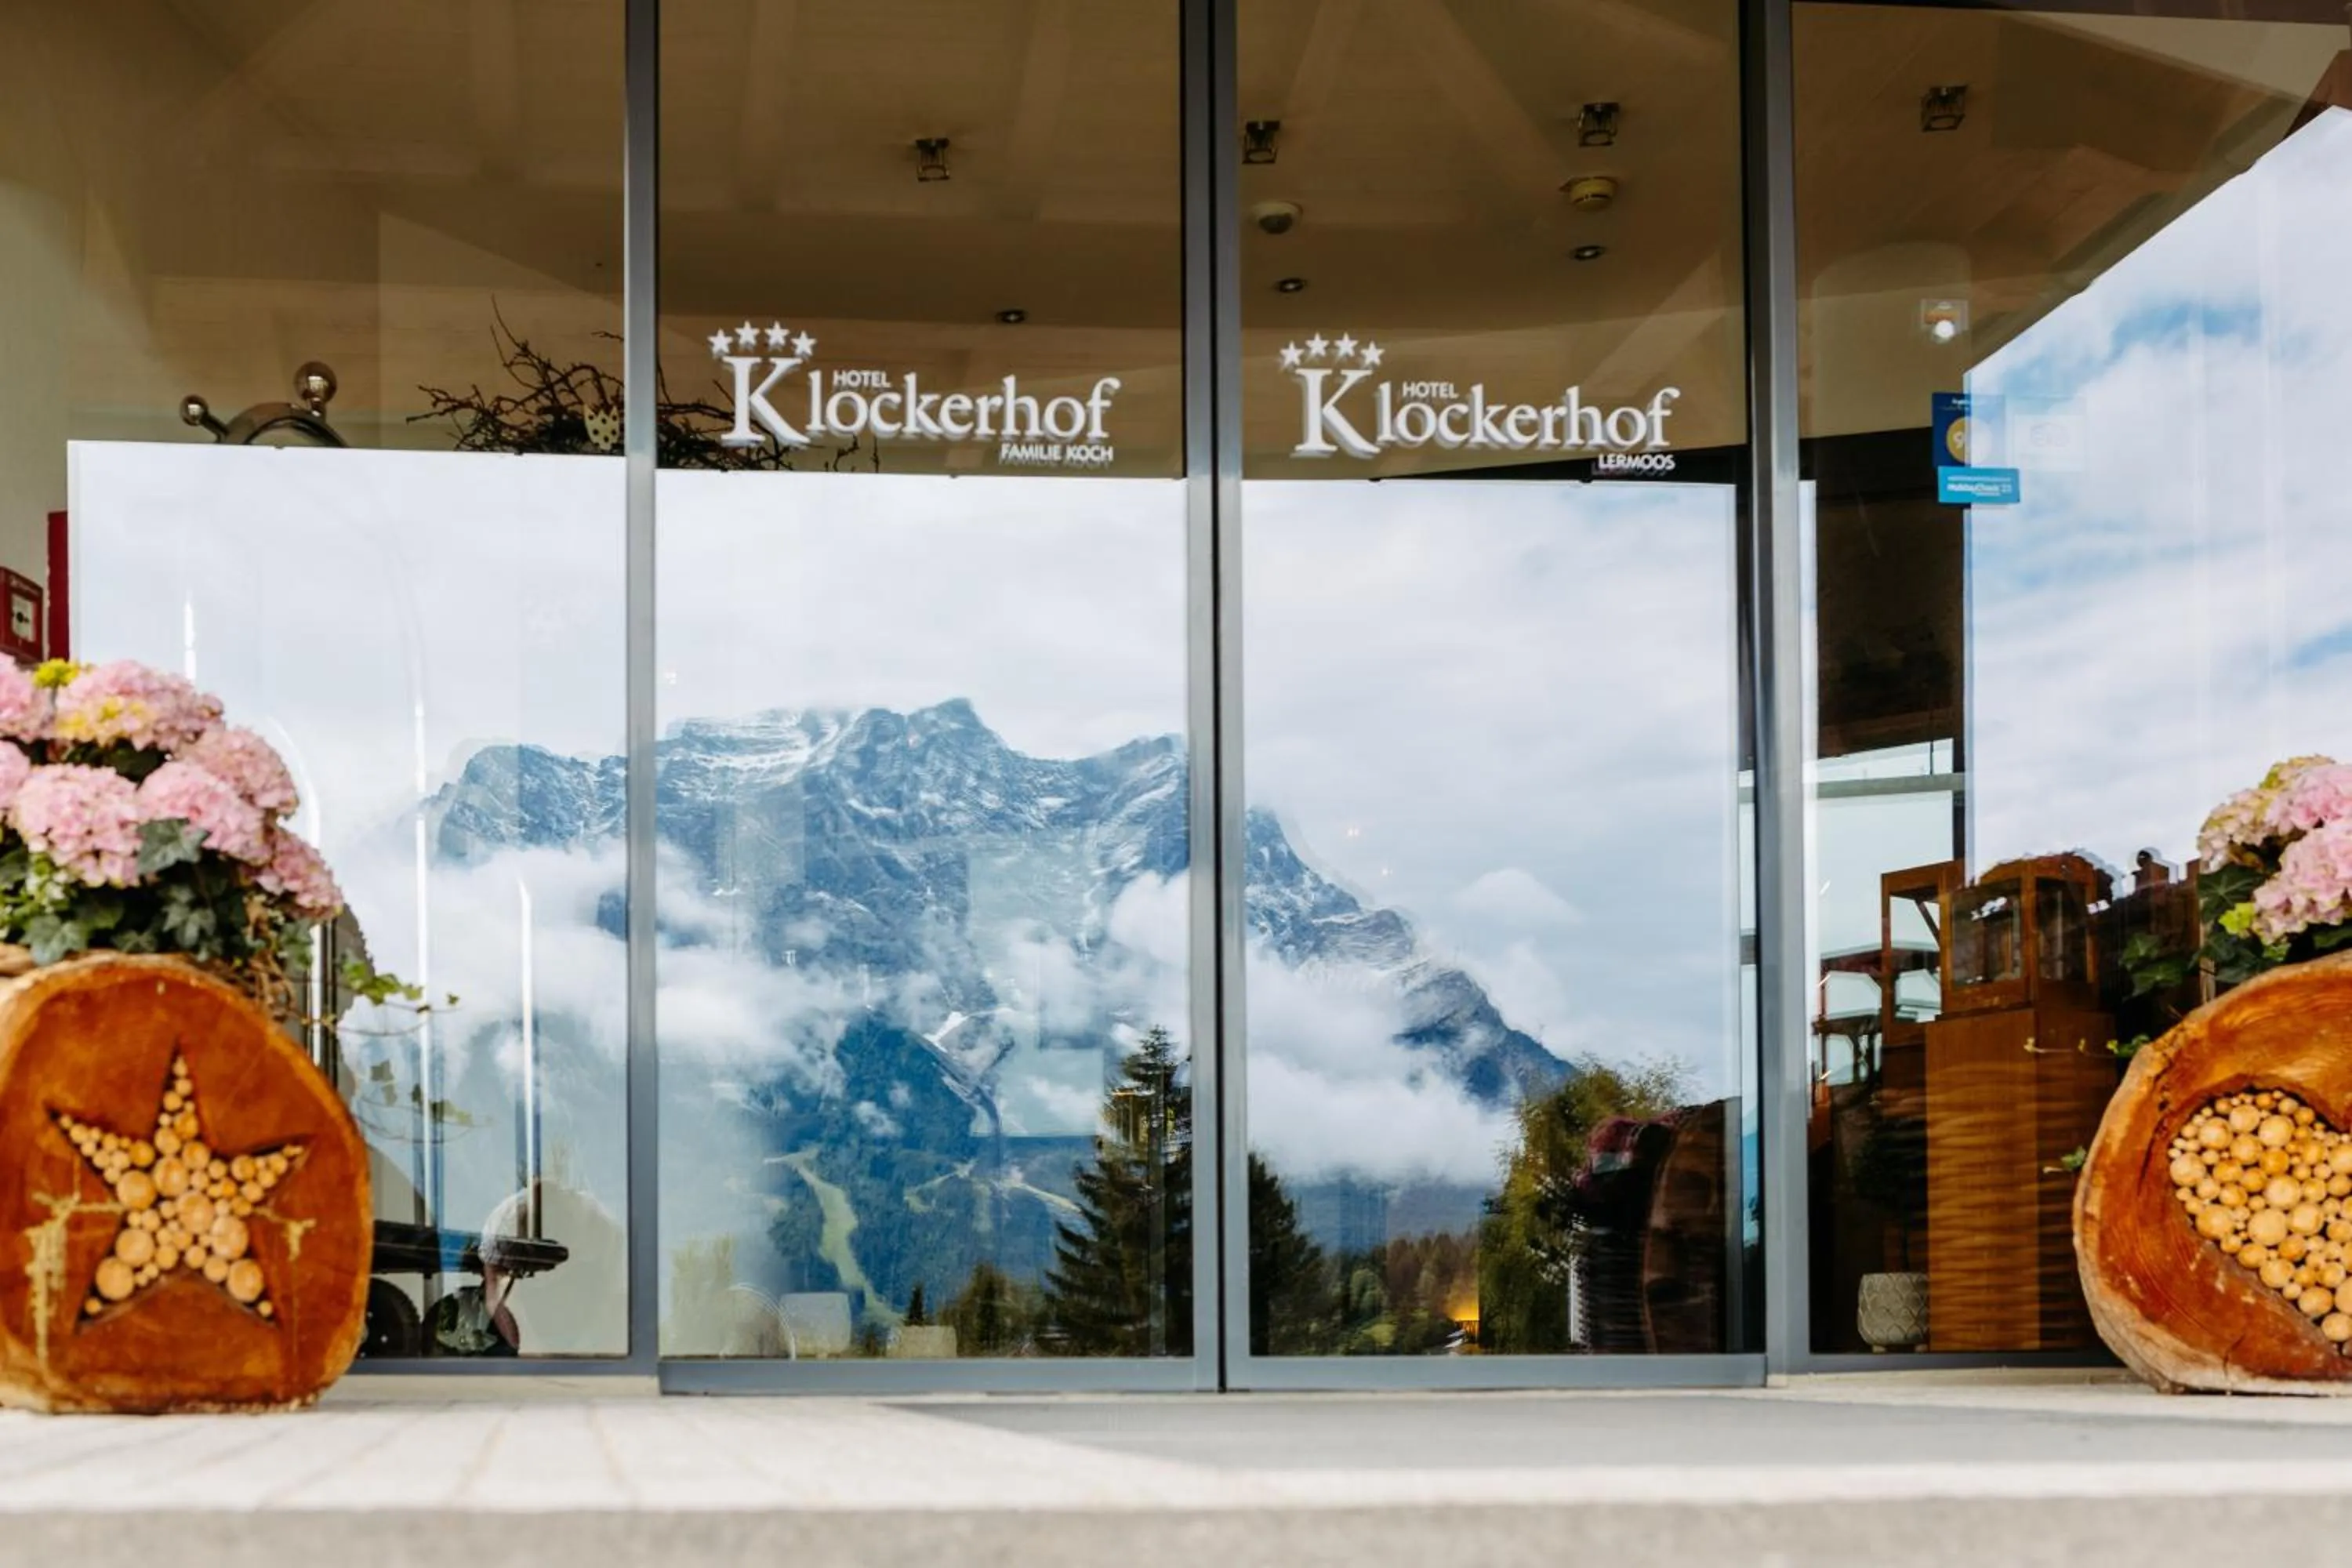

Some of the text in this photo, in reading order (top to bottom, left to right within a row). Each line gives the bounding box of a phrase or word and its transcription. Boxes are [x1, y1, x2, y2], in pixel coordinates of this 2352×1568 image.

[833, 369, 891, 387] HOTEL
[1402, 380, 1459, 399] HOTEL
[721, 357, 1121, 445] Klockerhof
[1295, 368, 1681, 455] Klockerhof
[1000, 442, 1114, 462] FAMILIE KOCH
[1598, 453, 1676, 470] LERMOOS
